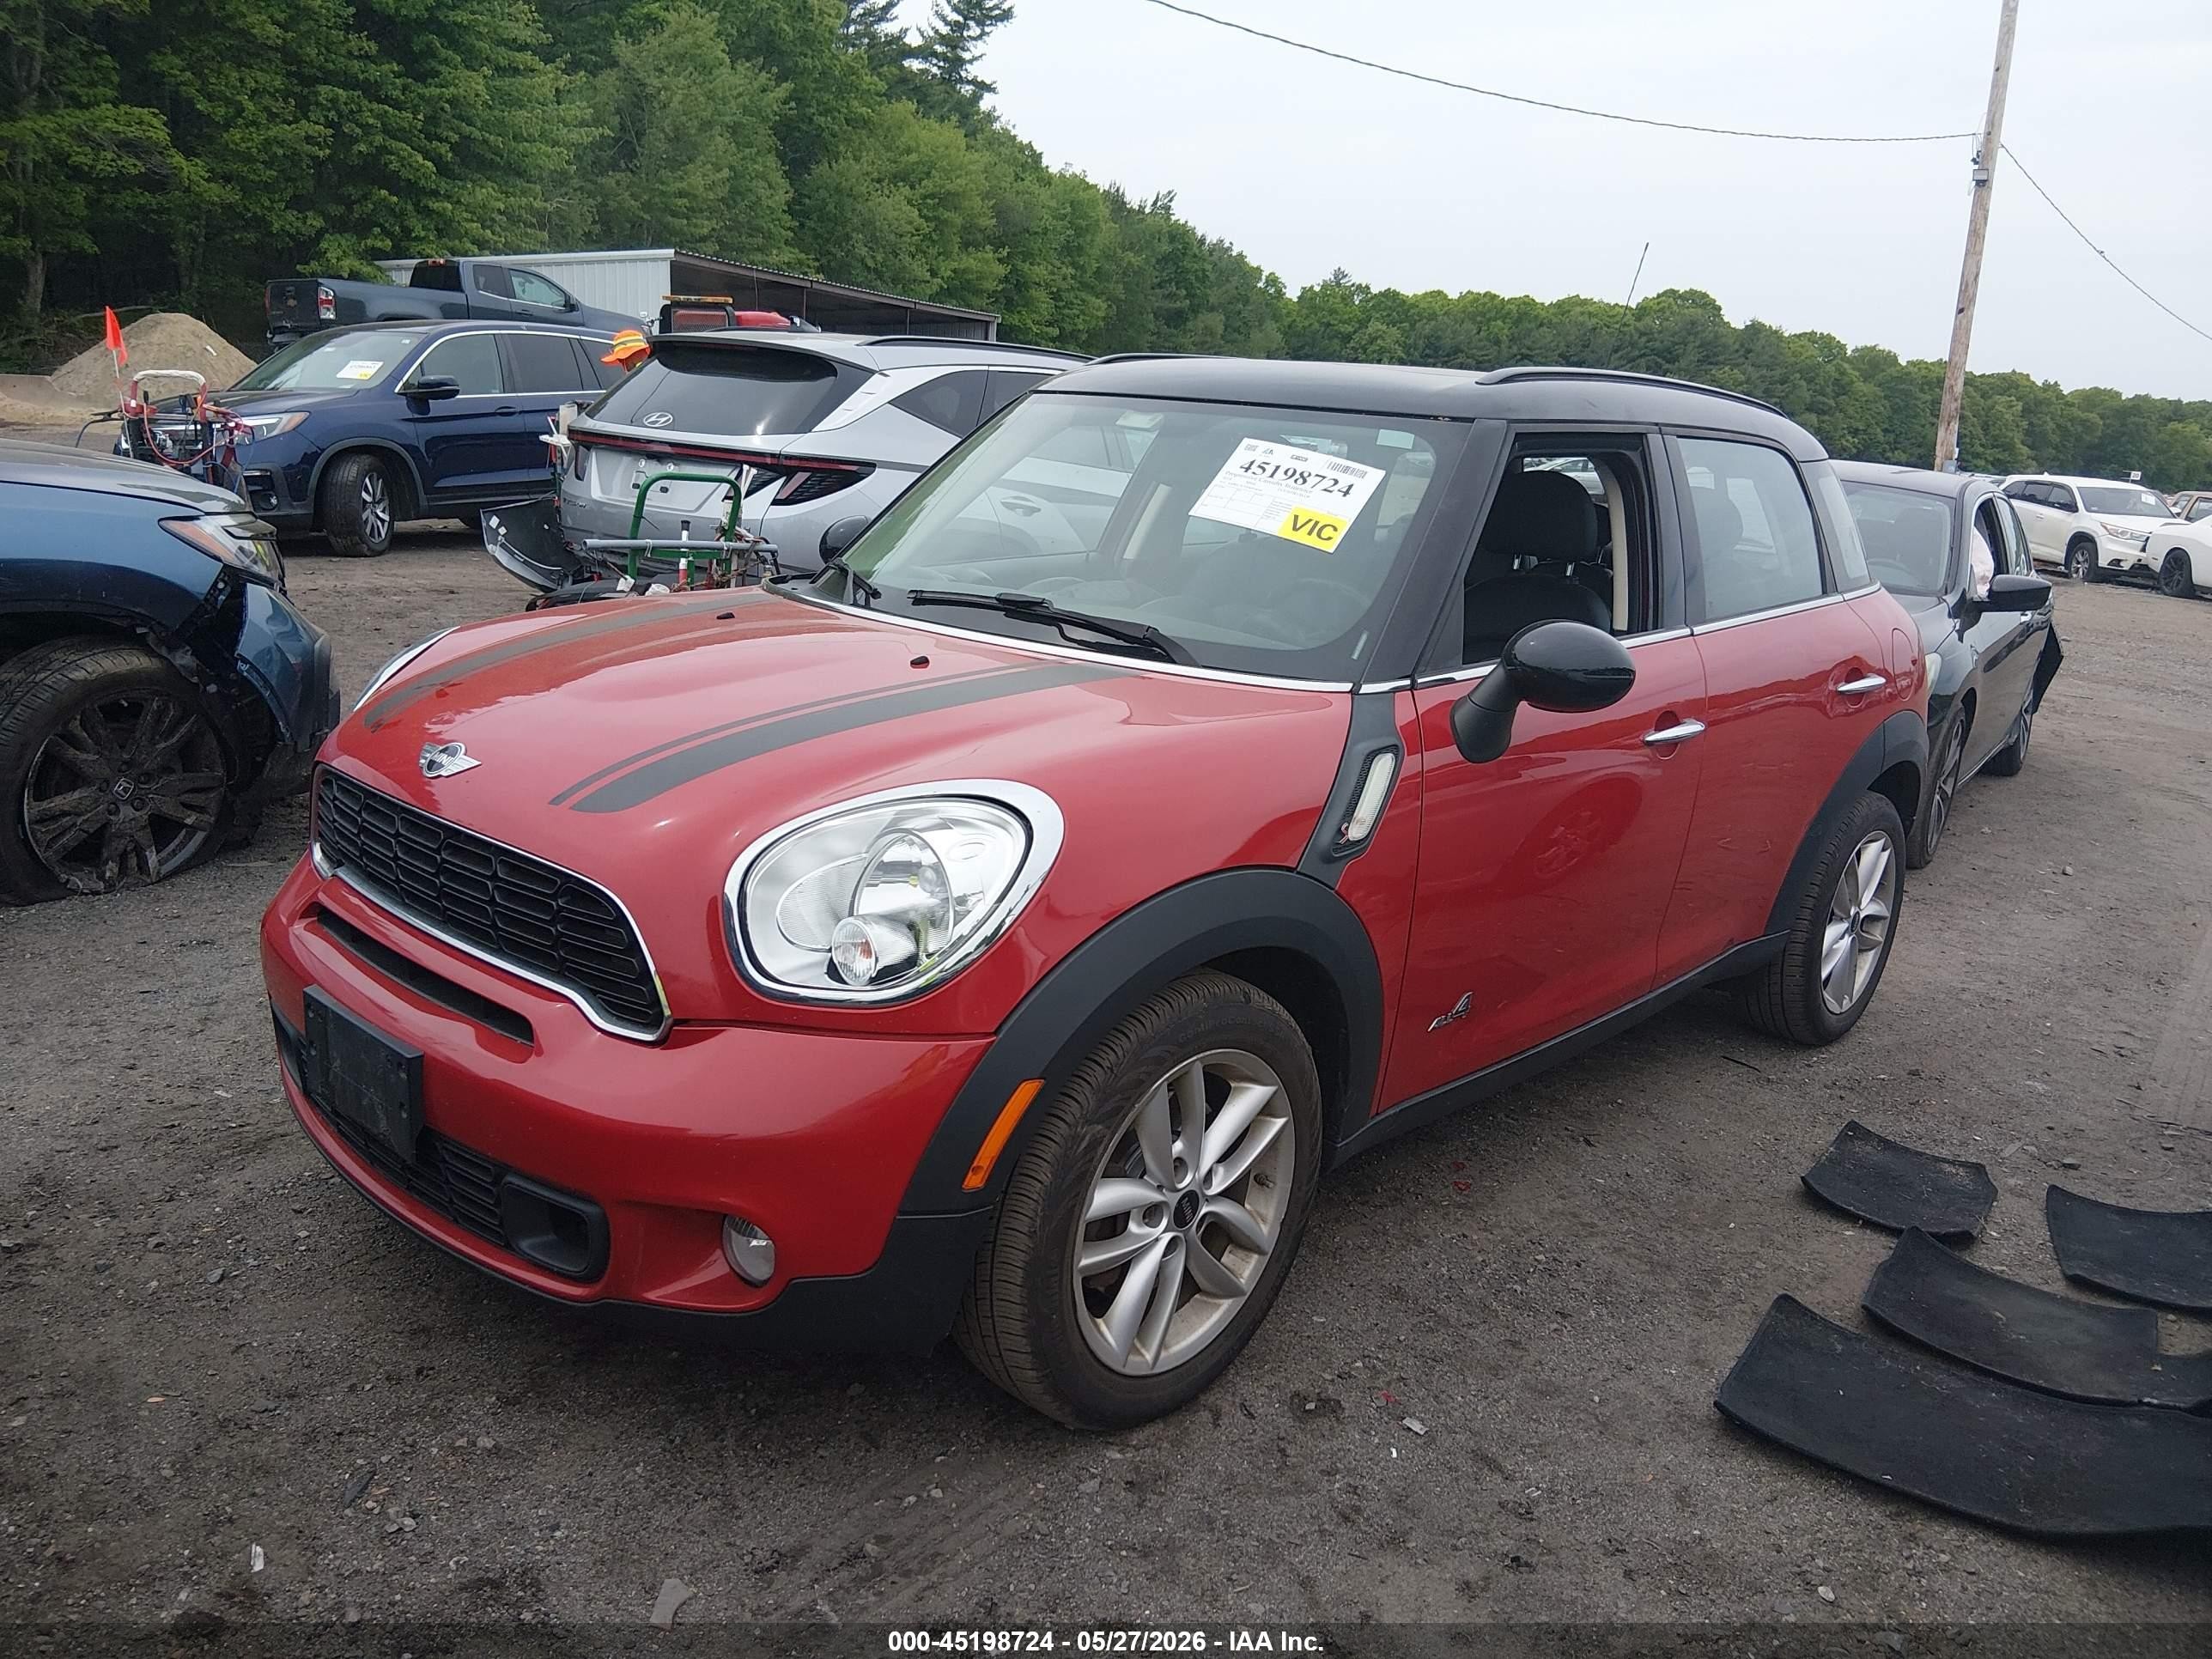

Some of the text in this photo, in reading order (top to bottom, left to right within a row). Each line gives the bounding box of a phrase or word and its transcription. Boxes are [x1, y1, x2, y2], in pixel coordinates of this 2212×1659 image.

[1239, 459, 1354, 497] 45198724
[1292, 514, 1338, 541] VIC
[430, 751, 454, 766] MINI
[1182, 1197, 1194, 1223] MINI
